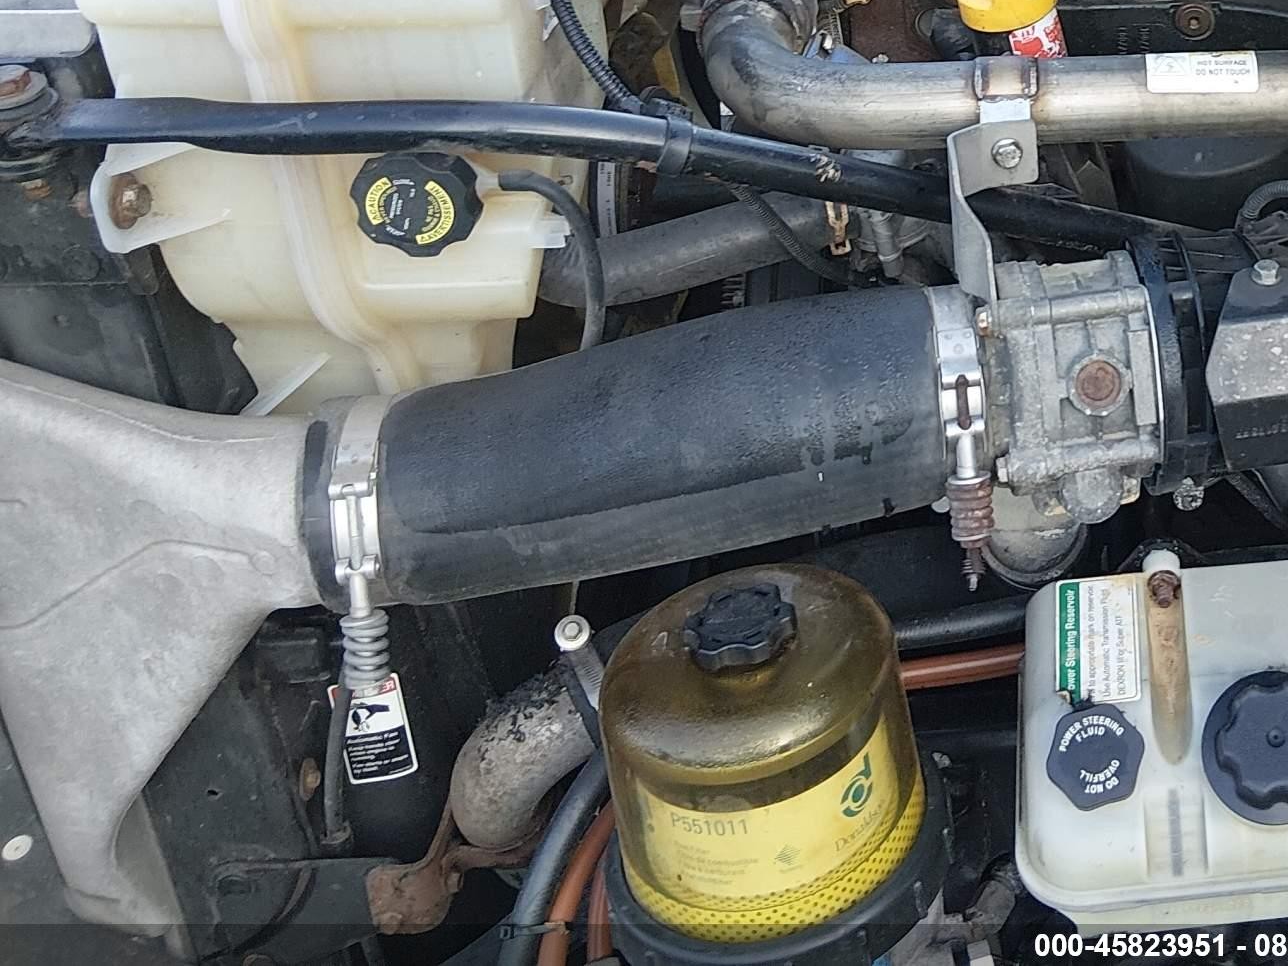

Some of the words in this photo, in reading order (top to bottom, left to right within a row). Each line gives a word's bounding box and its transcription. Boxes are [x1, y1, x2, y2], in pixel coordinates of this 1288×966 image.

[368, 179, 389, 215] CAUTION
[427, 185, 452, 240] AVERTISSEMENT
[1064, 589, 1076, 630] Reservoir
[1065, 630, 1078, 668] Steering
[1101, 648, 1111, 682] Automatic
[1066, 668, 1077, 691] ower
[1102, 682, 1111, 697] Use
[1059, 721, 1082, 752] POWER
[1082, 715, 1124, 736] STEERING
[1075, 726, 1105, 742] FLUID
[1080, 759, 1120, 783] OVERFILL
[1105, 776, 1119, 790] DO
[1084, 783, 1104, 794] NOT
[671, 812, 749, 836] P551011
